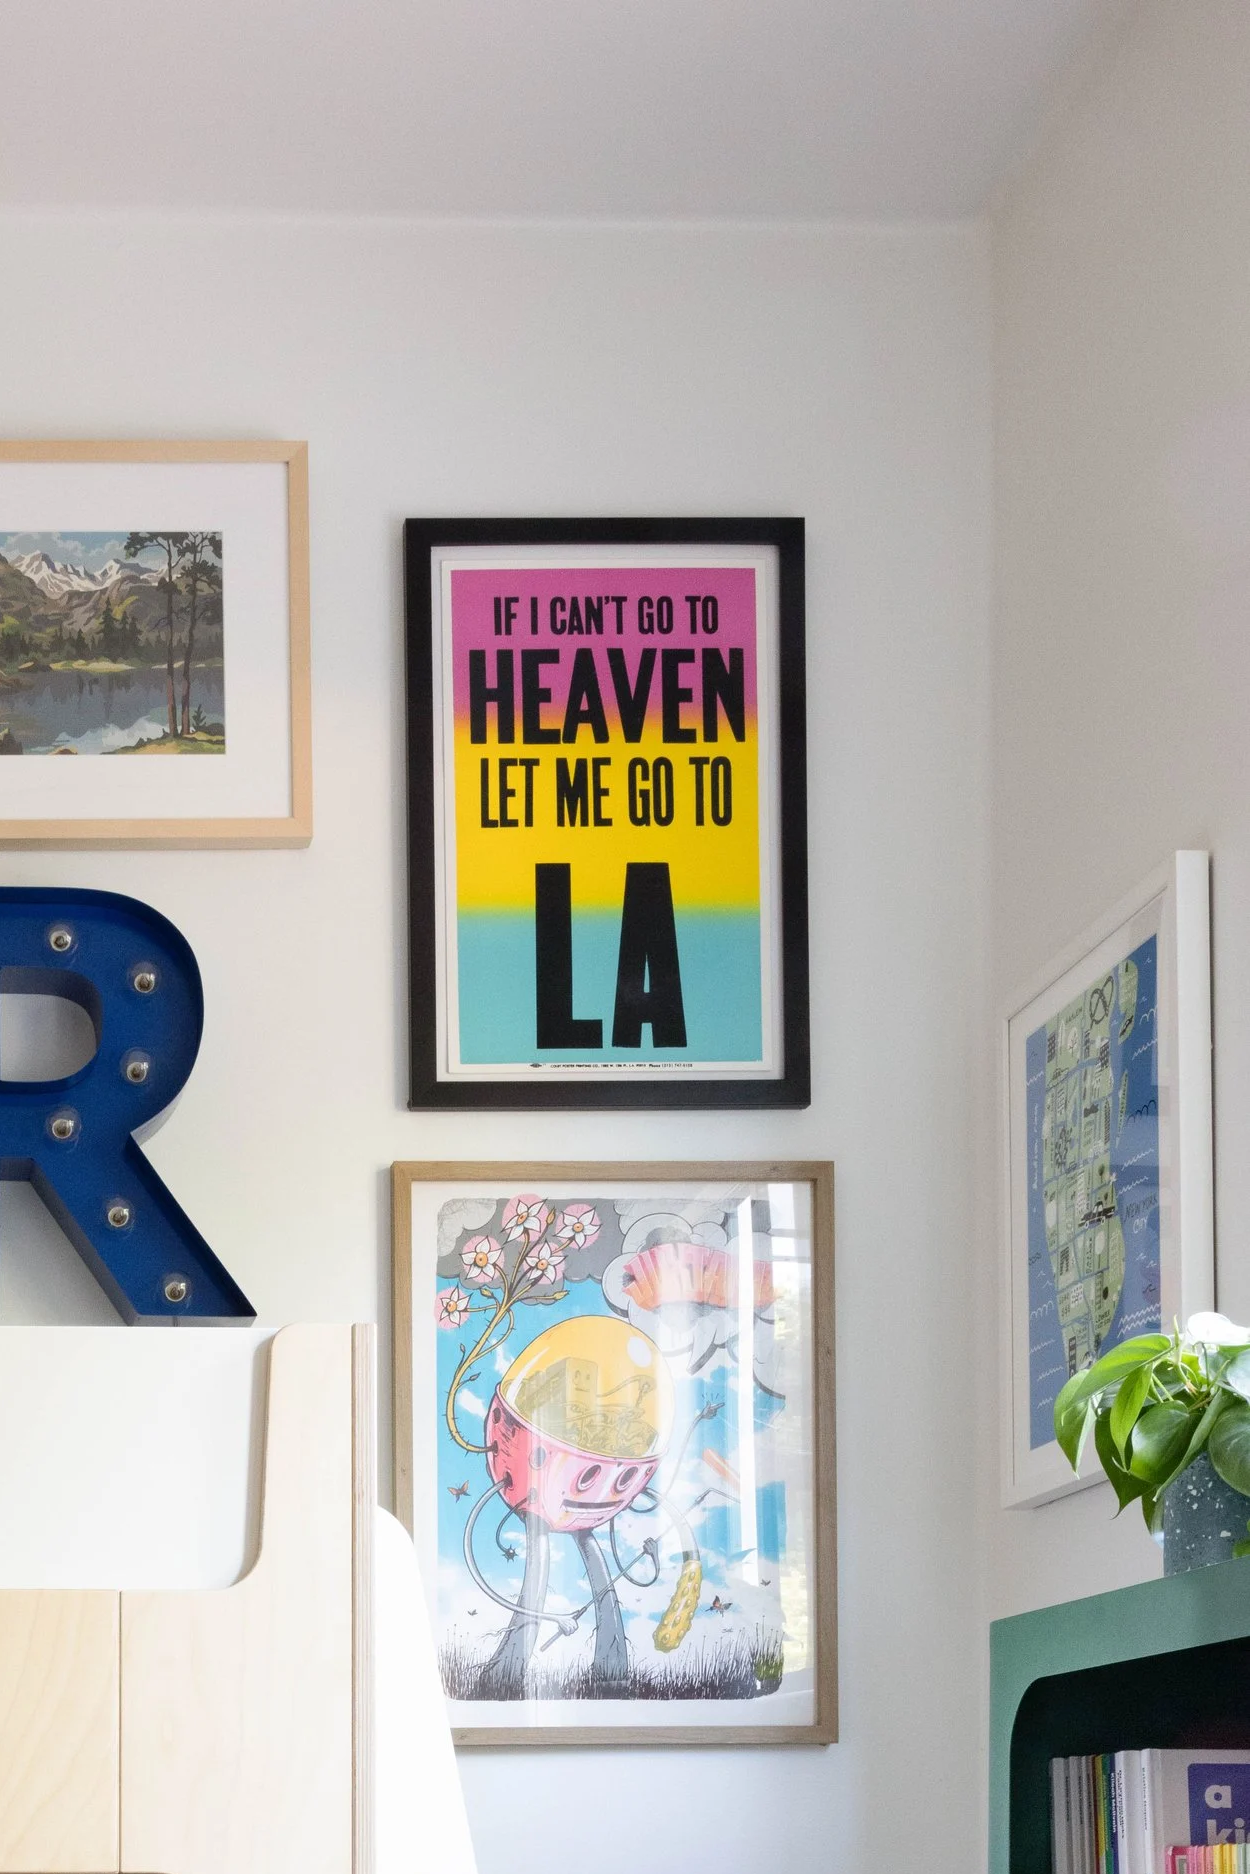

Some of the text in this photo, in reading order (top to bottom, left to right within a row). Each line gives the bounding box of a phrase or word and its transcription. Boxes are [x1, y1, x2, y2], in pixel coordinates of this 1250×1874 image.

[493, 595, 719, 635] IF I CAN'T GO TO
[468, 648, 746, 745] HEAVEN
[480, 756, 733, 828] LET ME GO TO
[535, 862, 688, 1050] LA
[1205, 1784, 1232, 1809] a
[1206, 1817, 1250, 1847] ki
